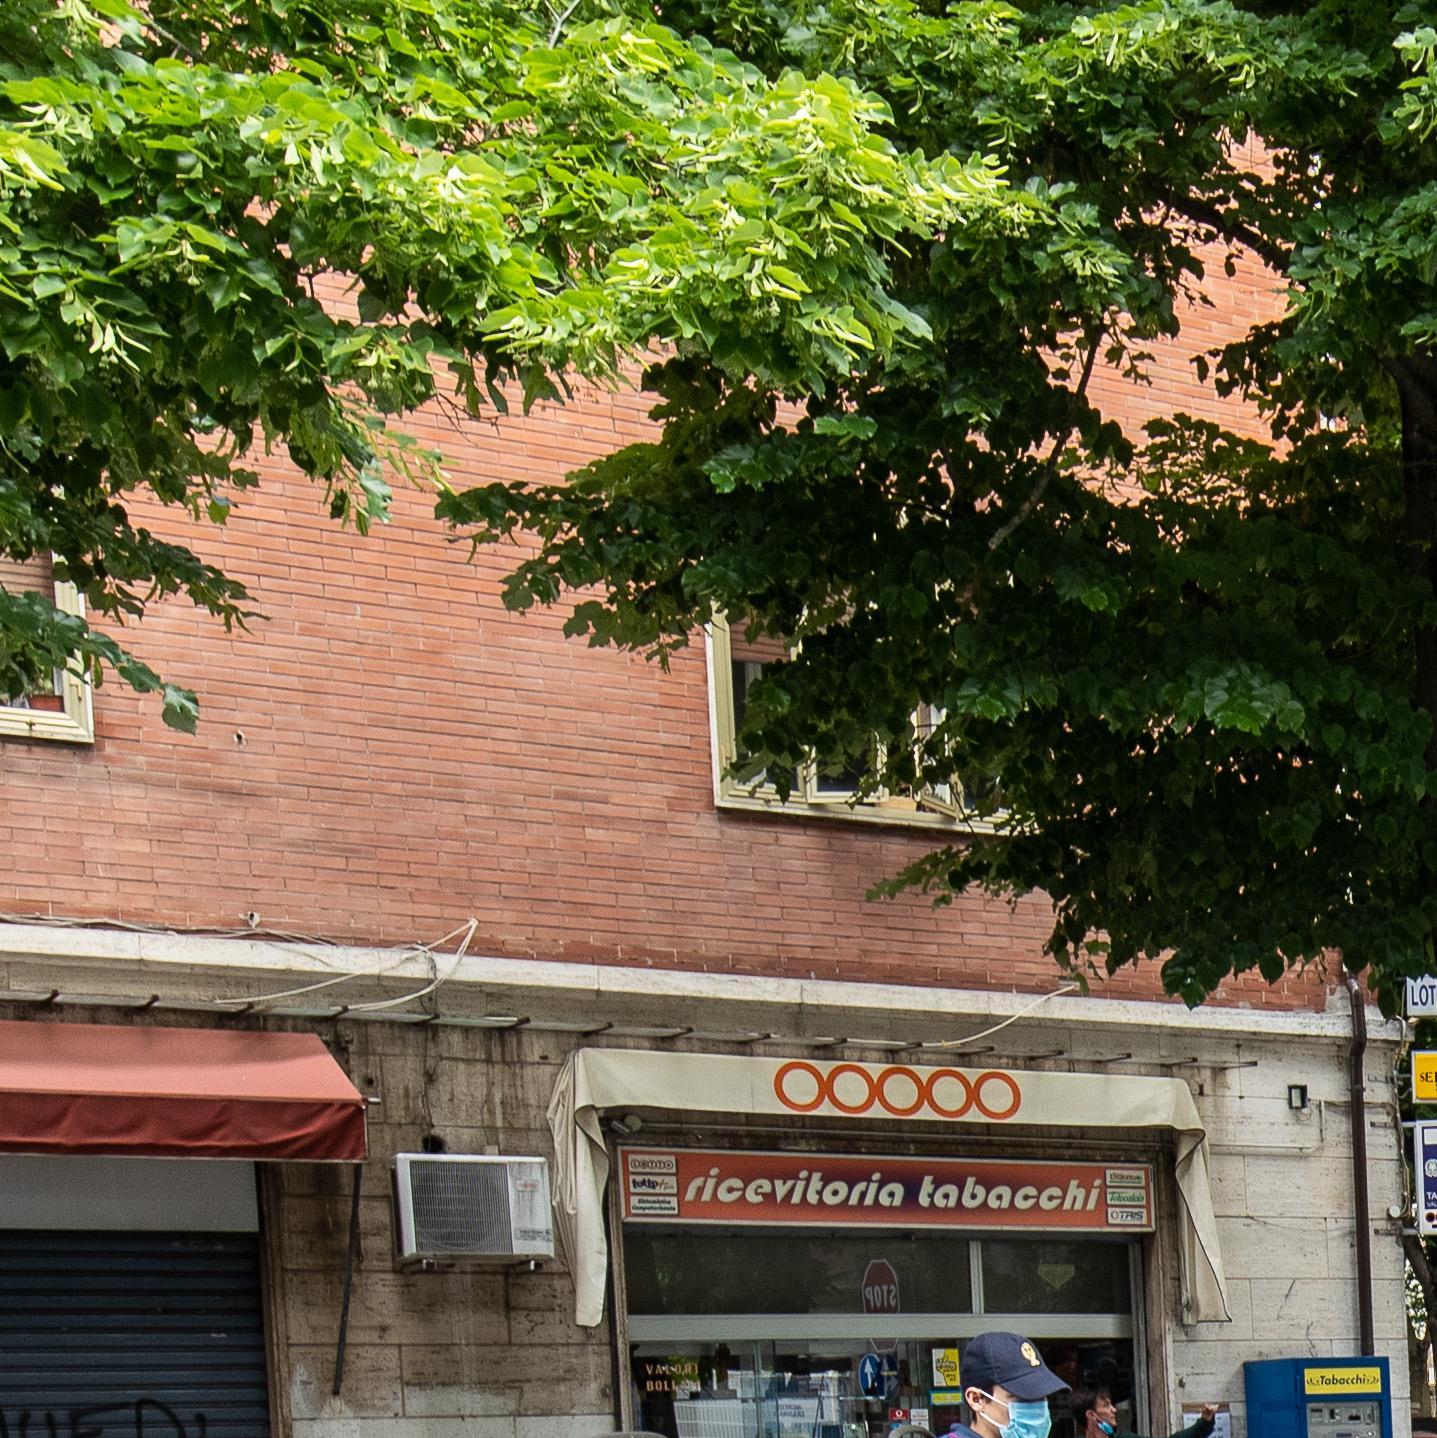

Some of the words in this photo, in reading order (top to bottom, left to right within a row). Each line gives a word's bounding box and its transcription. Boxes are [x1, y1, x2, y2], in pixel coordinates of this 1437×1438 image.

[684, 1167, 904, 1207] ricevitoria
[918, 1175, 1102, 1211] tabacchi
[1320, 1373, 1365, 1386] Tabacchi
